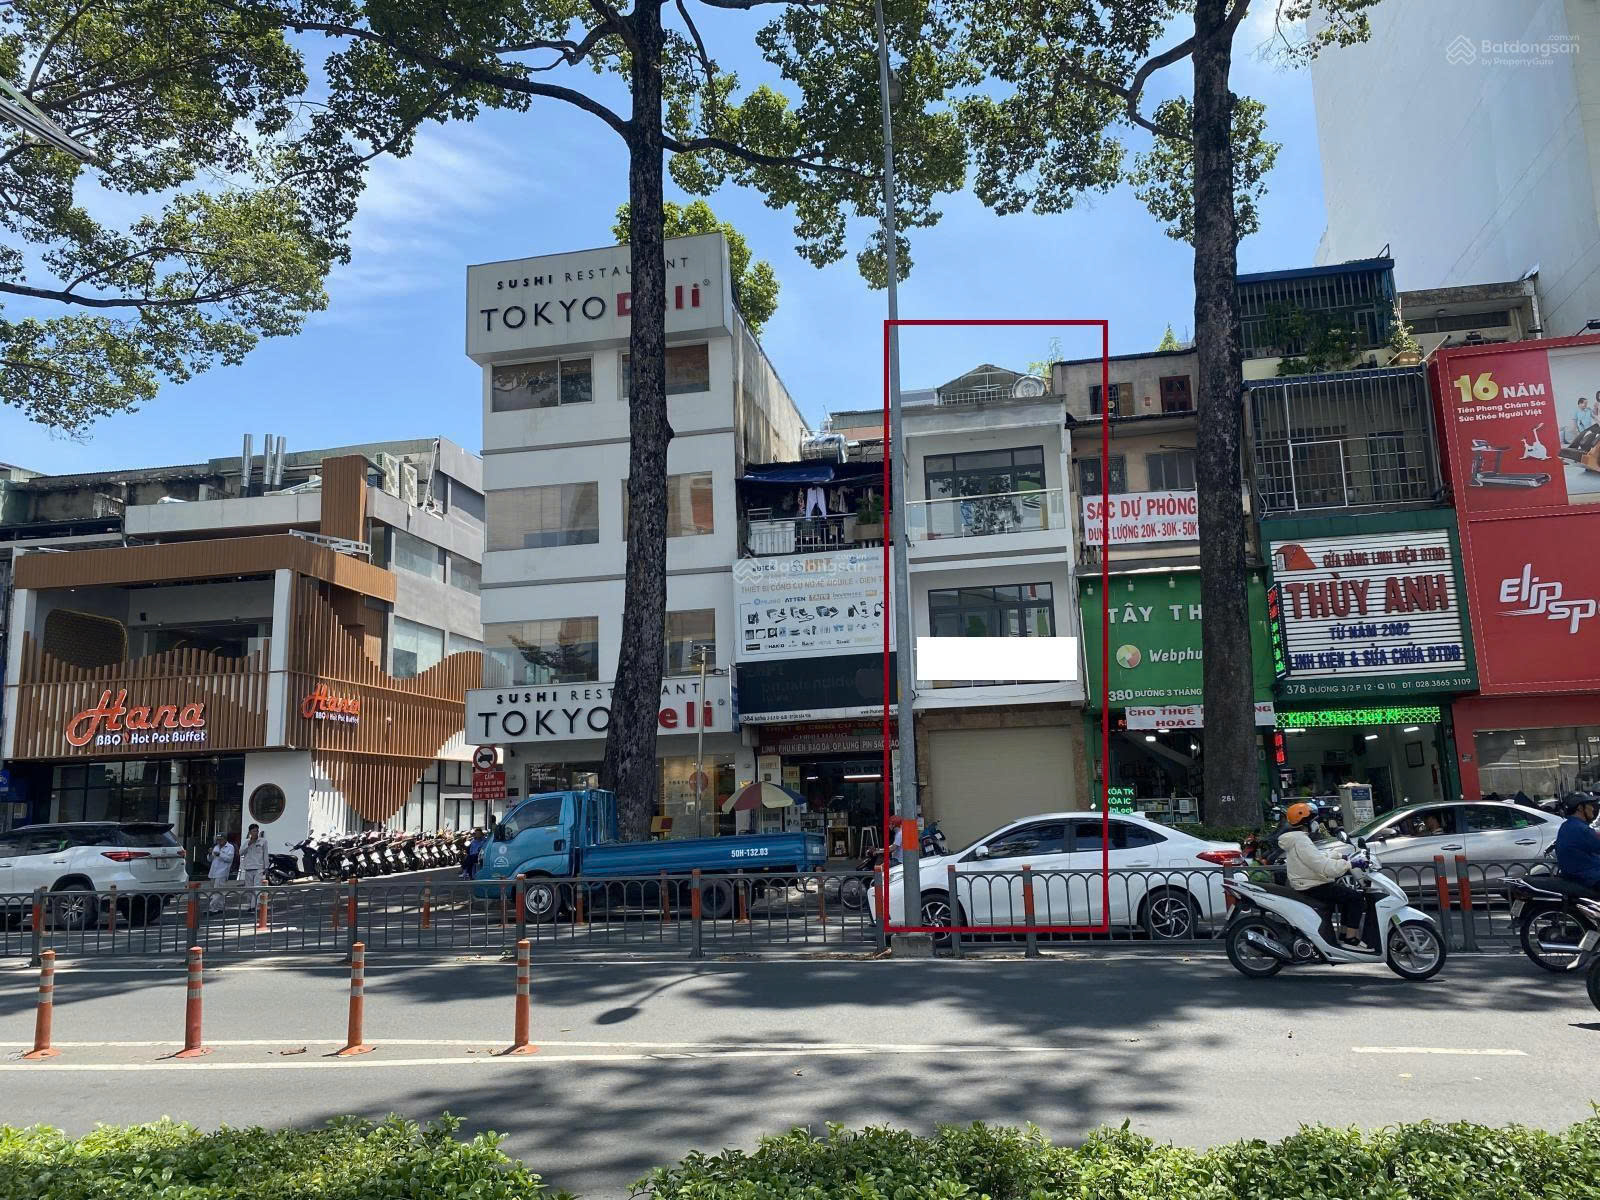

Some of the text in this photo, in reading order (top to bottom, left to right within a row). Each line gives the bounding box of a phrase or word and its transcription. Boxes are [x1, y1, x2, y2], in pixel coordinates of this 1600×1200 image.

[497, 257, 688, 290] SUSHI RESTAUNT
[480, 283, 700, 331] TOKYO Dli
[1454, 372, 1545, 402] 16 NĂM
[1476, 404, 1503, 412] Phong
[1524, 408, 1542, 417] Việt
[1121, 496, 1141, 521] DỰ
[1146, 493, 1197, 516] PHÒNG
[1088, 527, 1110, 541] DUN
[1141, 522, 1157, 538] 20K
[1162, 522, 1178, 536] 30K
[1286, 572, 1449, 620] THÙY ANH
[1108, 602, 1202, 623] TÂY TH
[1328, 621, 1410, 640] TỪ NĂM 2002
[1149, 647, 1202, 664] Webphu
[1351, 650, 1359, 667] &
[496, 683, 701, 704] SUSHI RESTANT
[1108, 689, 1133, 701] 380
[1286, 684, 1307, 695] 378
[302, 682, 360, 718] Hana
[66, 689, 206, 747] Hana
[478, 701, 713, 737] TOKYO eli
[1129, 709, 1155, 717] CHO
[1160, 707, 1195, 716] THUÊ
[96, 731, 206, 747] BBQ Hot Pot Buffet
[731, 847, 769, 858] 50H-132.03
